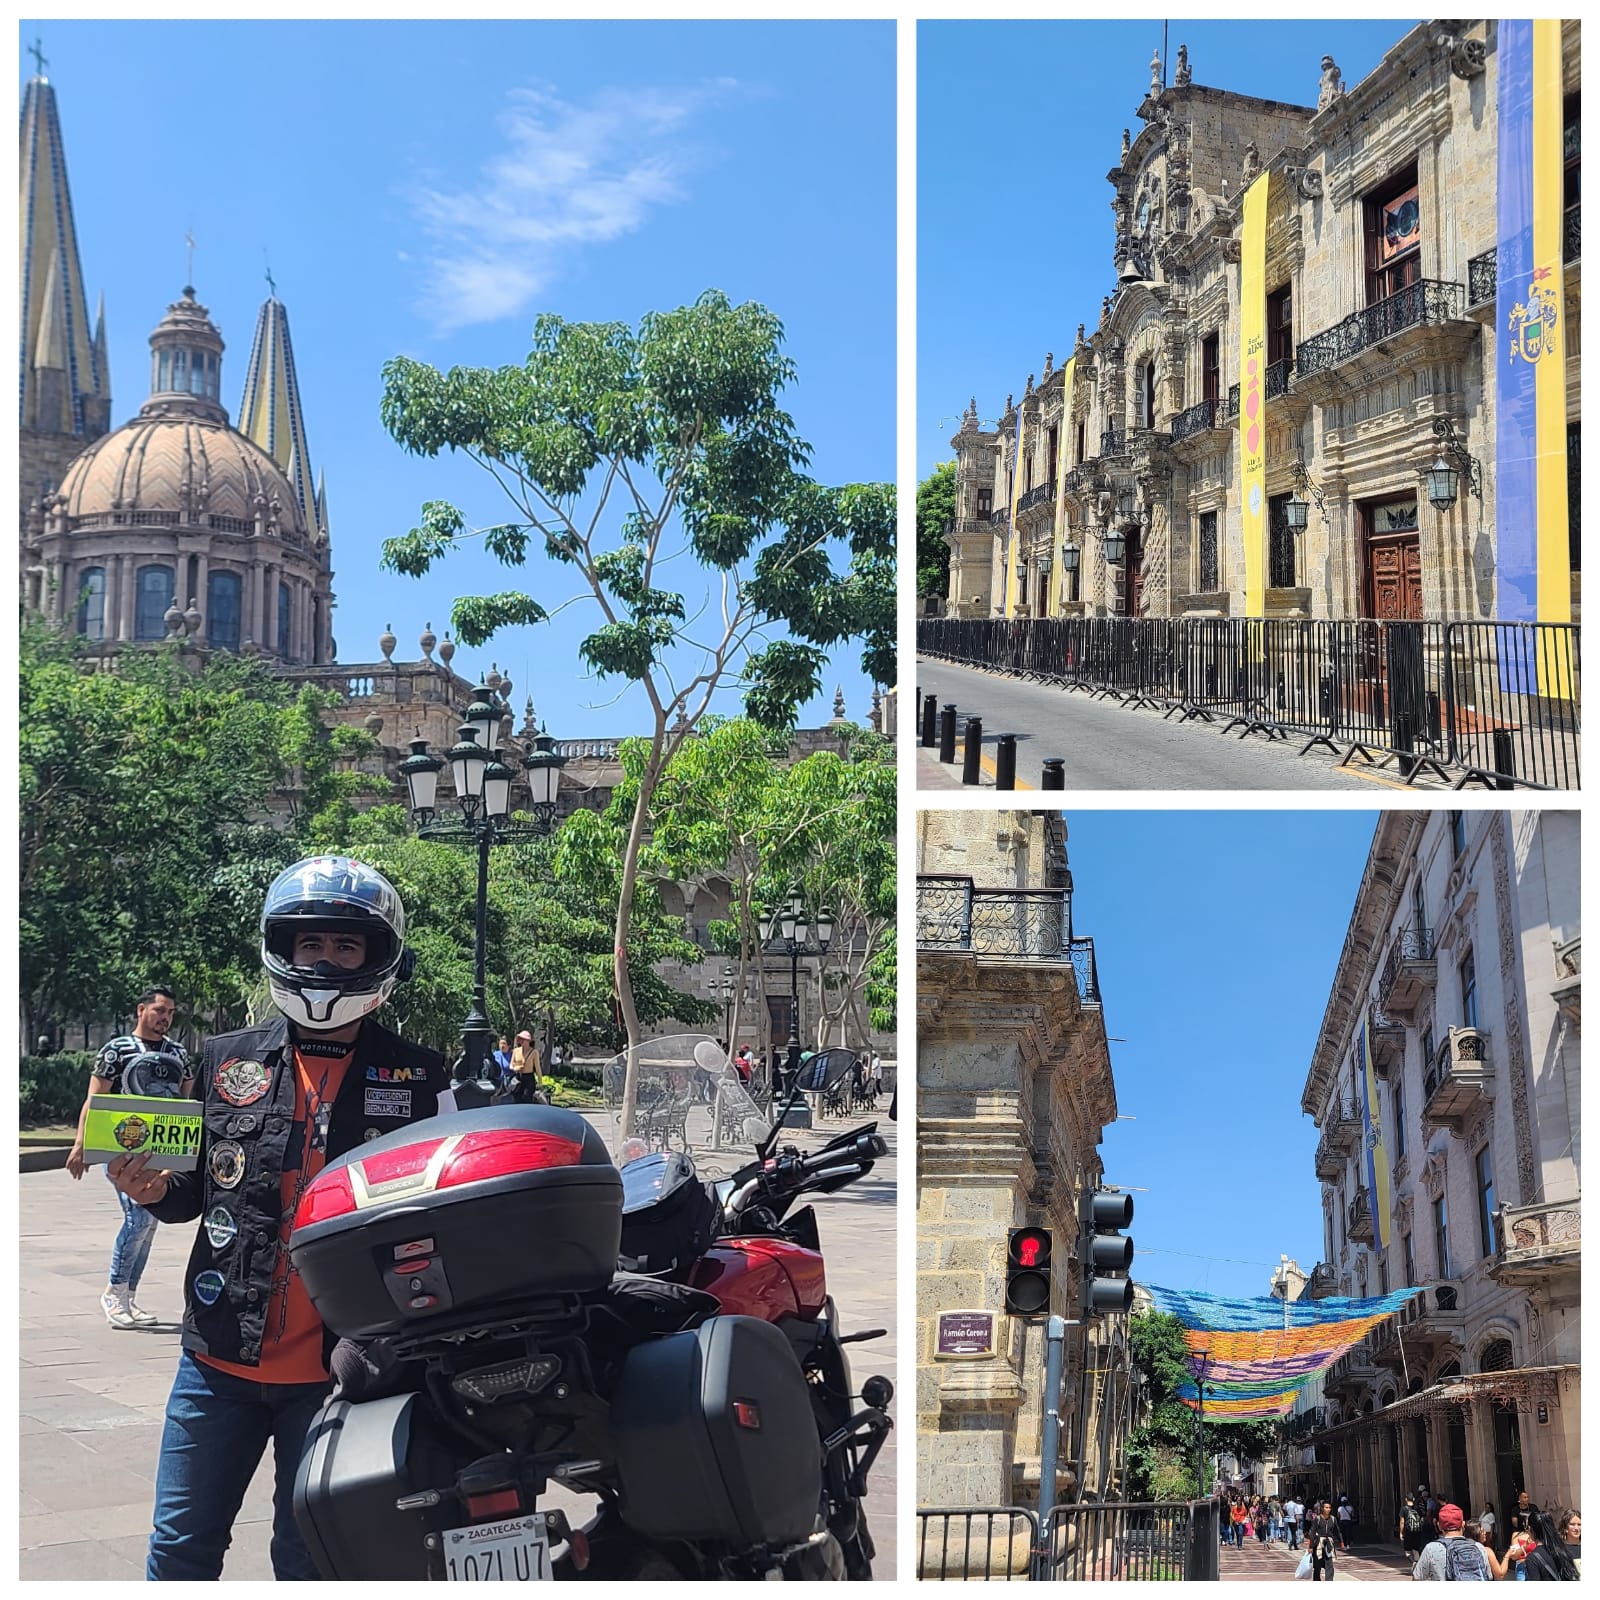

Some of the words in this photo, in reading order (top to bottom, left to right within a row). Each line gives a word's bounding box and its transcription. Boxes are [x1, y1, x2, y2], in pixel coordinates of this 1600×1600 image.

[367, 1104, 400, 1114] BERNARDO
[154, 1114, 201, 1126] MOTOTURISTA
[152, 1124, 200, 1145] RRM
[943, 1329, 966, 1337] Ramón
[966, 1329, 988, 1337] Corona
[468, 1522, 522, 1540] ZACATECAS
